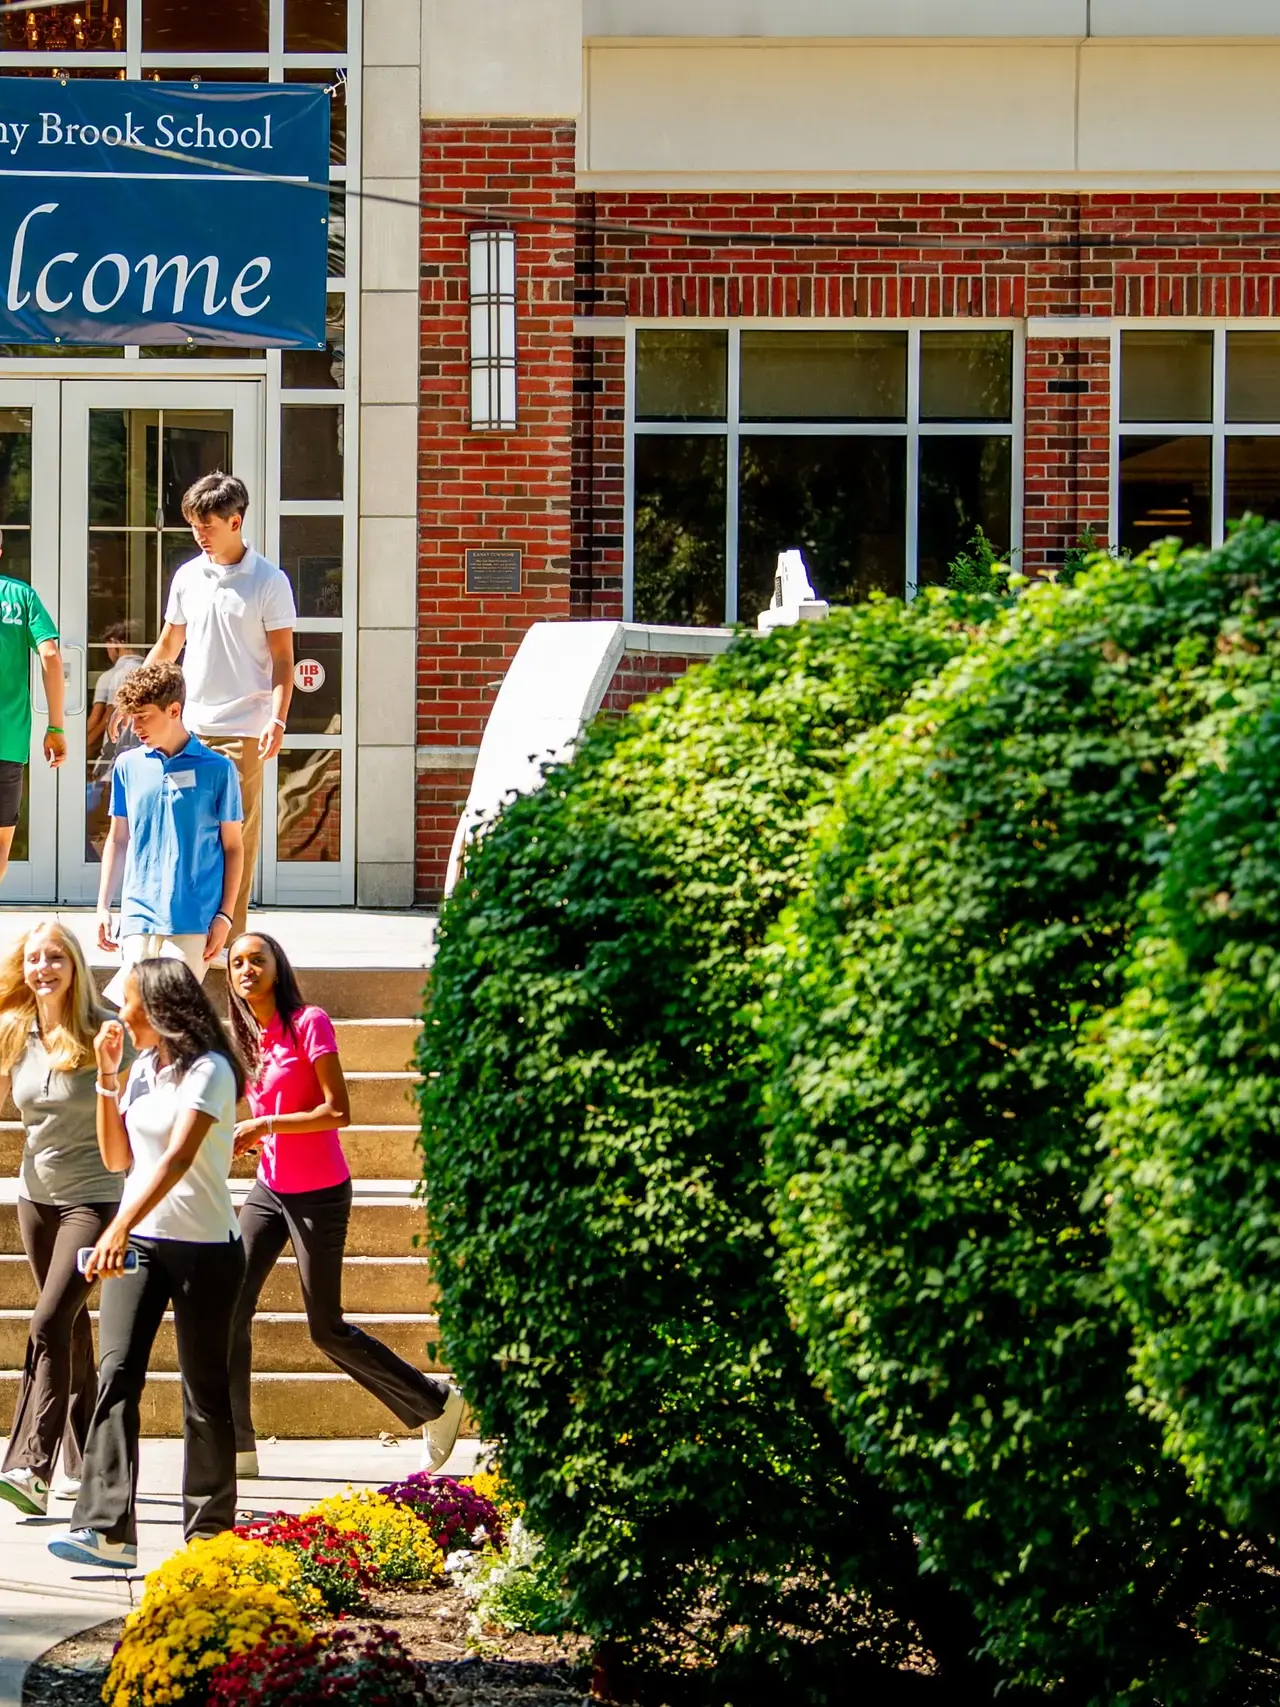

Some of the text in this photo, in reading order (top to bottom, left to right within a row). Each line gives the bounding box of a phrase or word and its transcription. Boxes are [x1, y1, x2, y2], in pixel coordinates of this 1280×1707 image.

[38, 111, 146, 147] Brook
[155, 114, 273, 150] School
[303, 676, 314, 687] R
